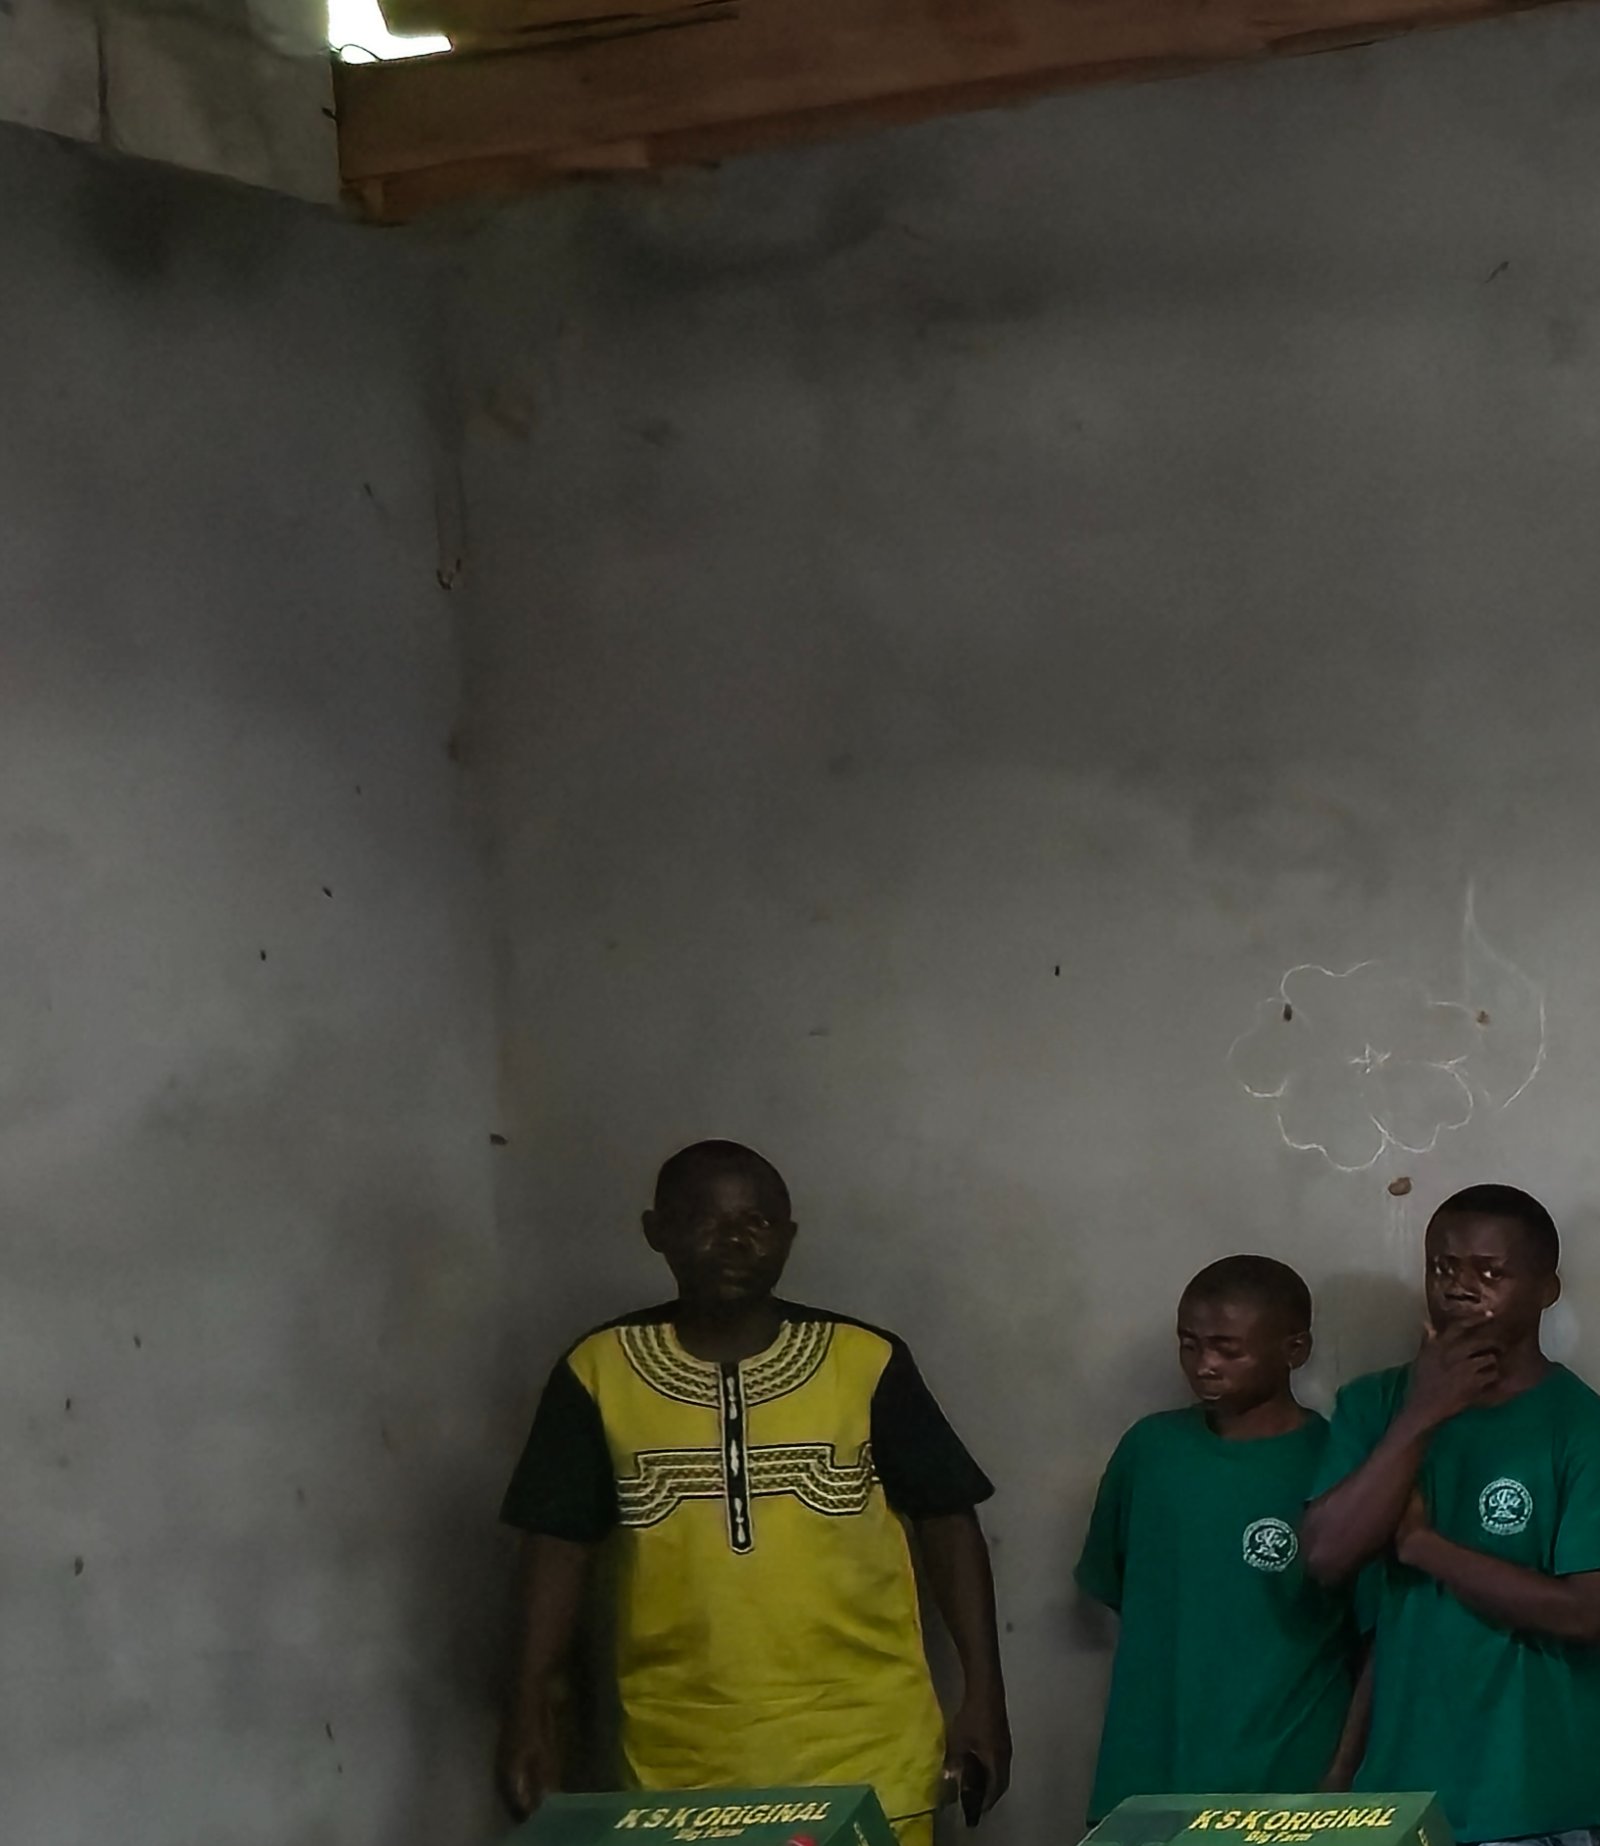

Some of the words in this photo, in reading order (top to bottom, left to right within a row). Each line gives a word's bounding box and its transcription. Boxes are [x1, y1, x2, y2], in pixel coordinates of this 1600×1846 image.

[696, 1800, 832, 1826] ORIGINAL
[1188, 1810, 1216, 1829] K
[1215, 1811, 1239, 1829] S
[1236, 1810, 1270, 1829] K
[1263, 1807, 1398, 1830] ORIGINAL
